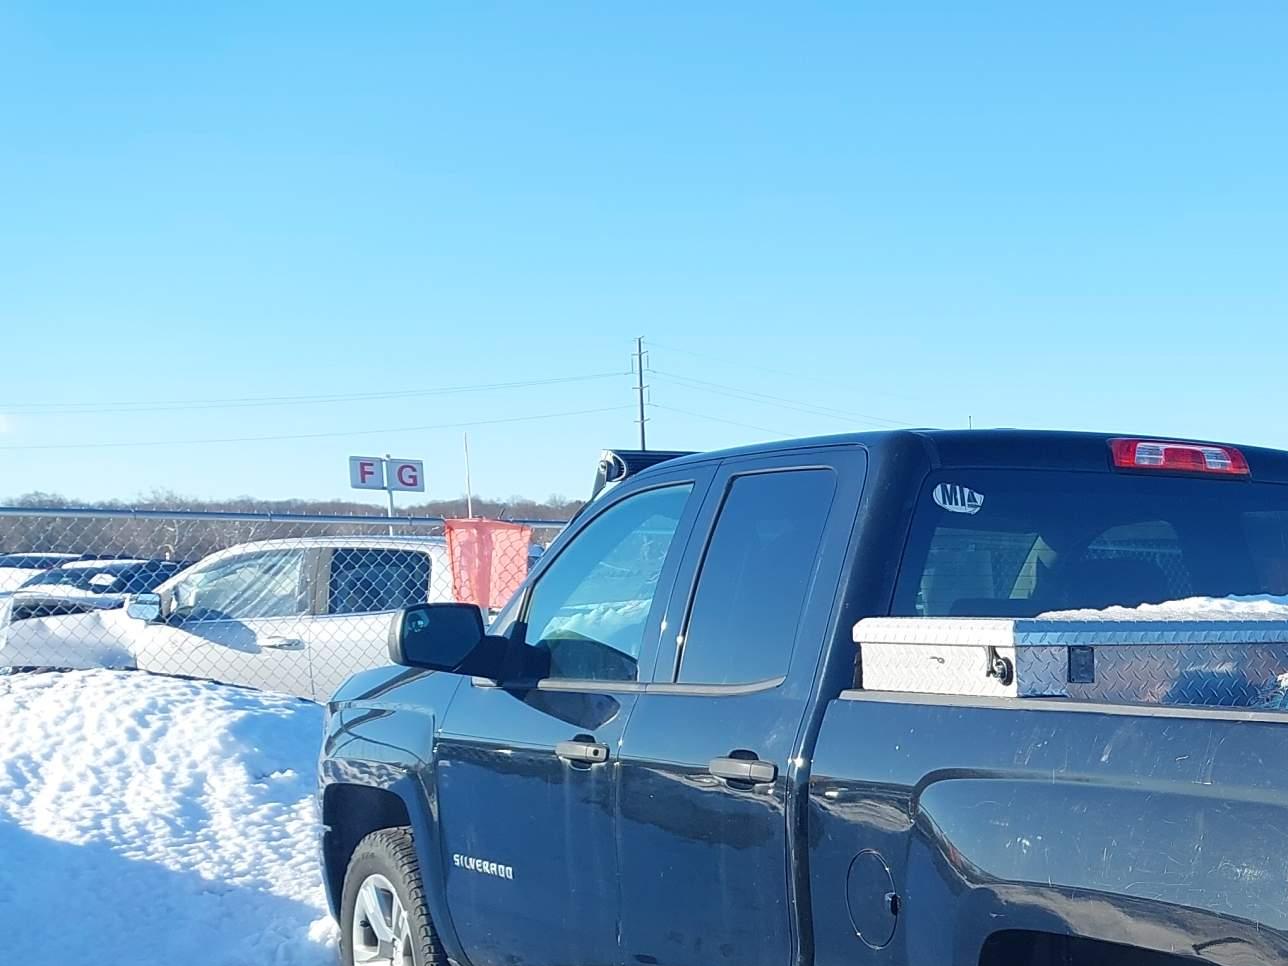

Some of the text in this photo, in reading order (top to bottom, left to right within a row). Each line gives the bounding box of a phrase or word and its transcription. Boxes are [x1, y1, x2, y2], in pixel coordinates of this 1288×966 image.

[360, 462, 374, 483] F
[397, 464, 418, 486] G
[453, 853, 514, 880] SILVERADO
